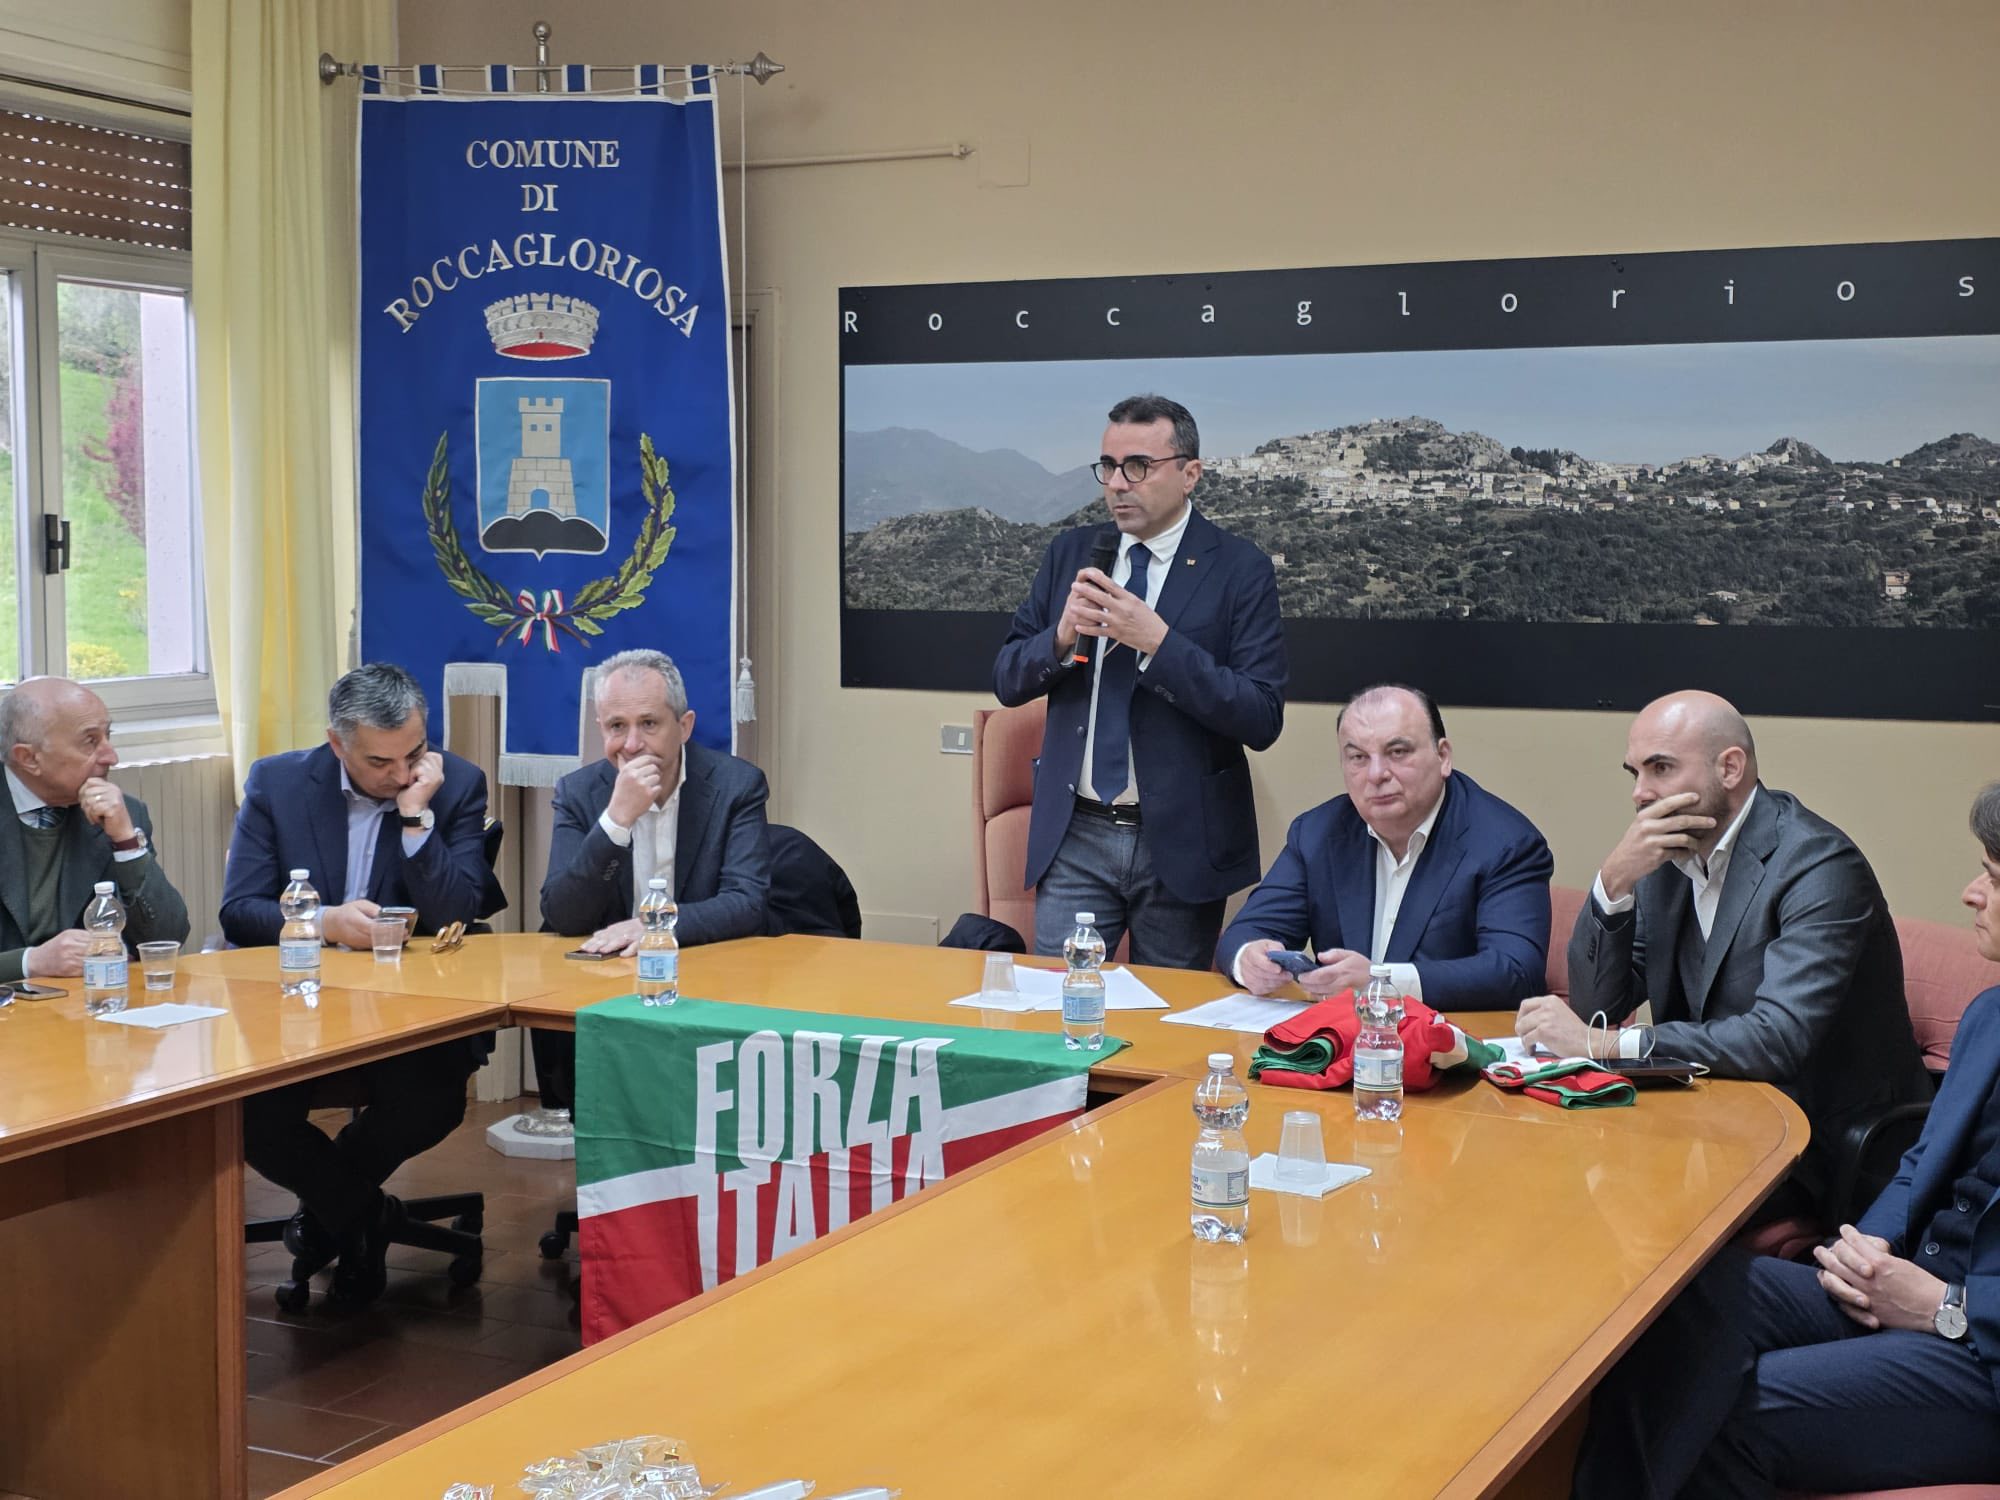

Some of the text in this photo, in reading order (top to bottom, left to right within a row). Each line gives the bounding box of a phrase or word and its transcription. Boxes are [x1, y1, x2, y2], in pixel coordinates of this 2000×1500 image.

[466, 139, 620, 169] COMUNE
[521, 184, 559, 212] DI
[383, 233, 701, 338] ROCCAGLORIOSA
[695, 1030, 956, 1173] FORZA
